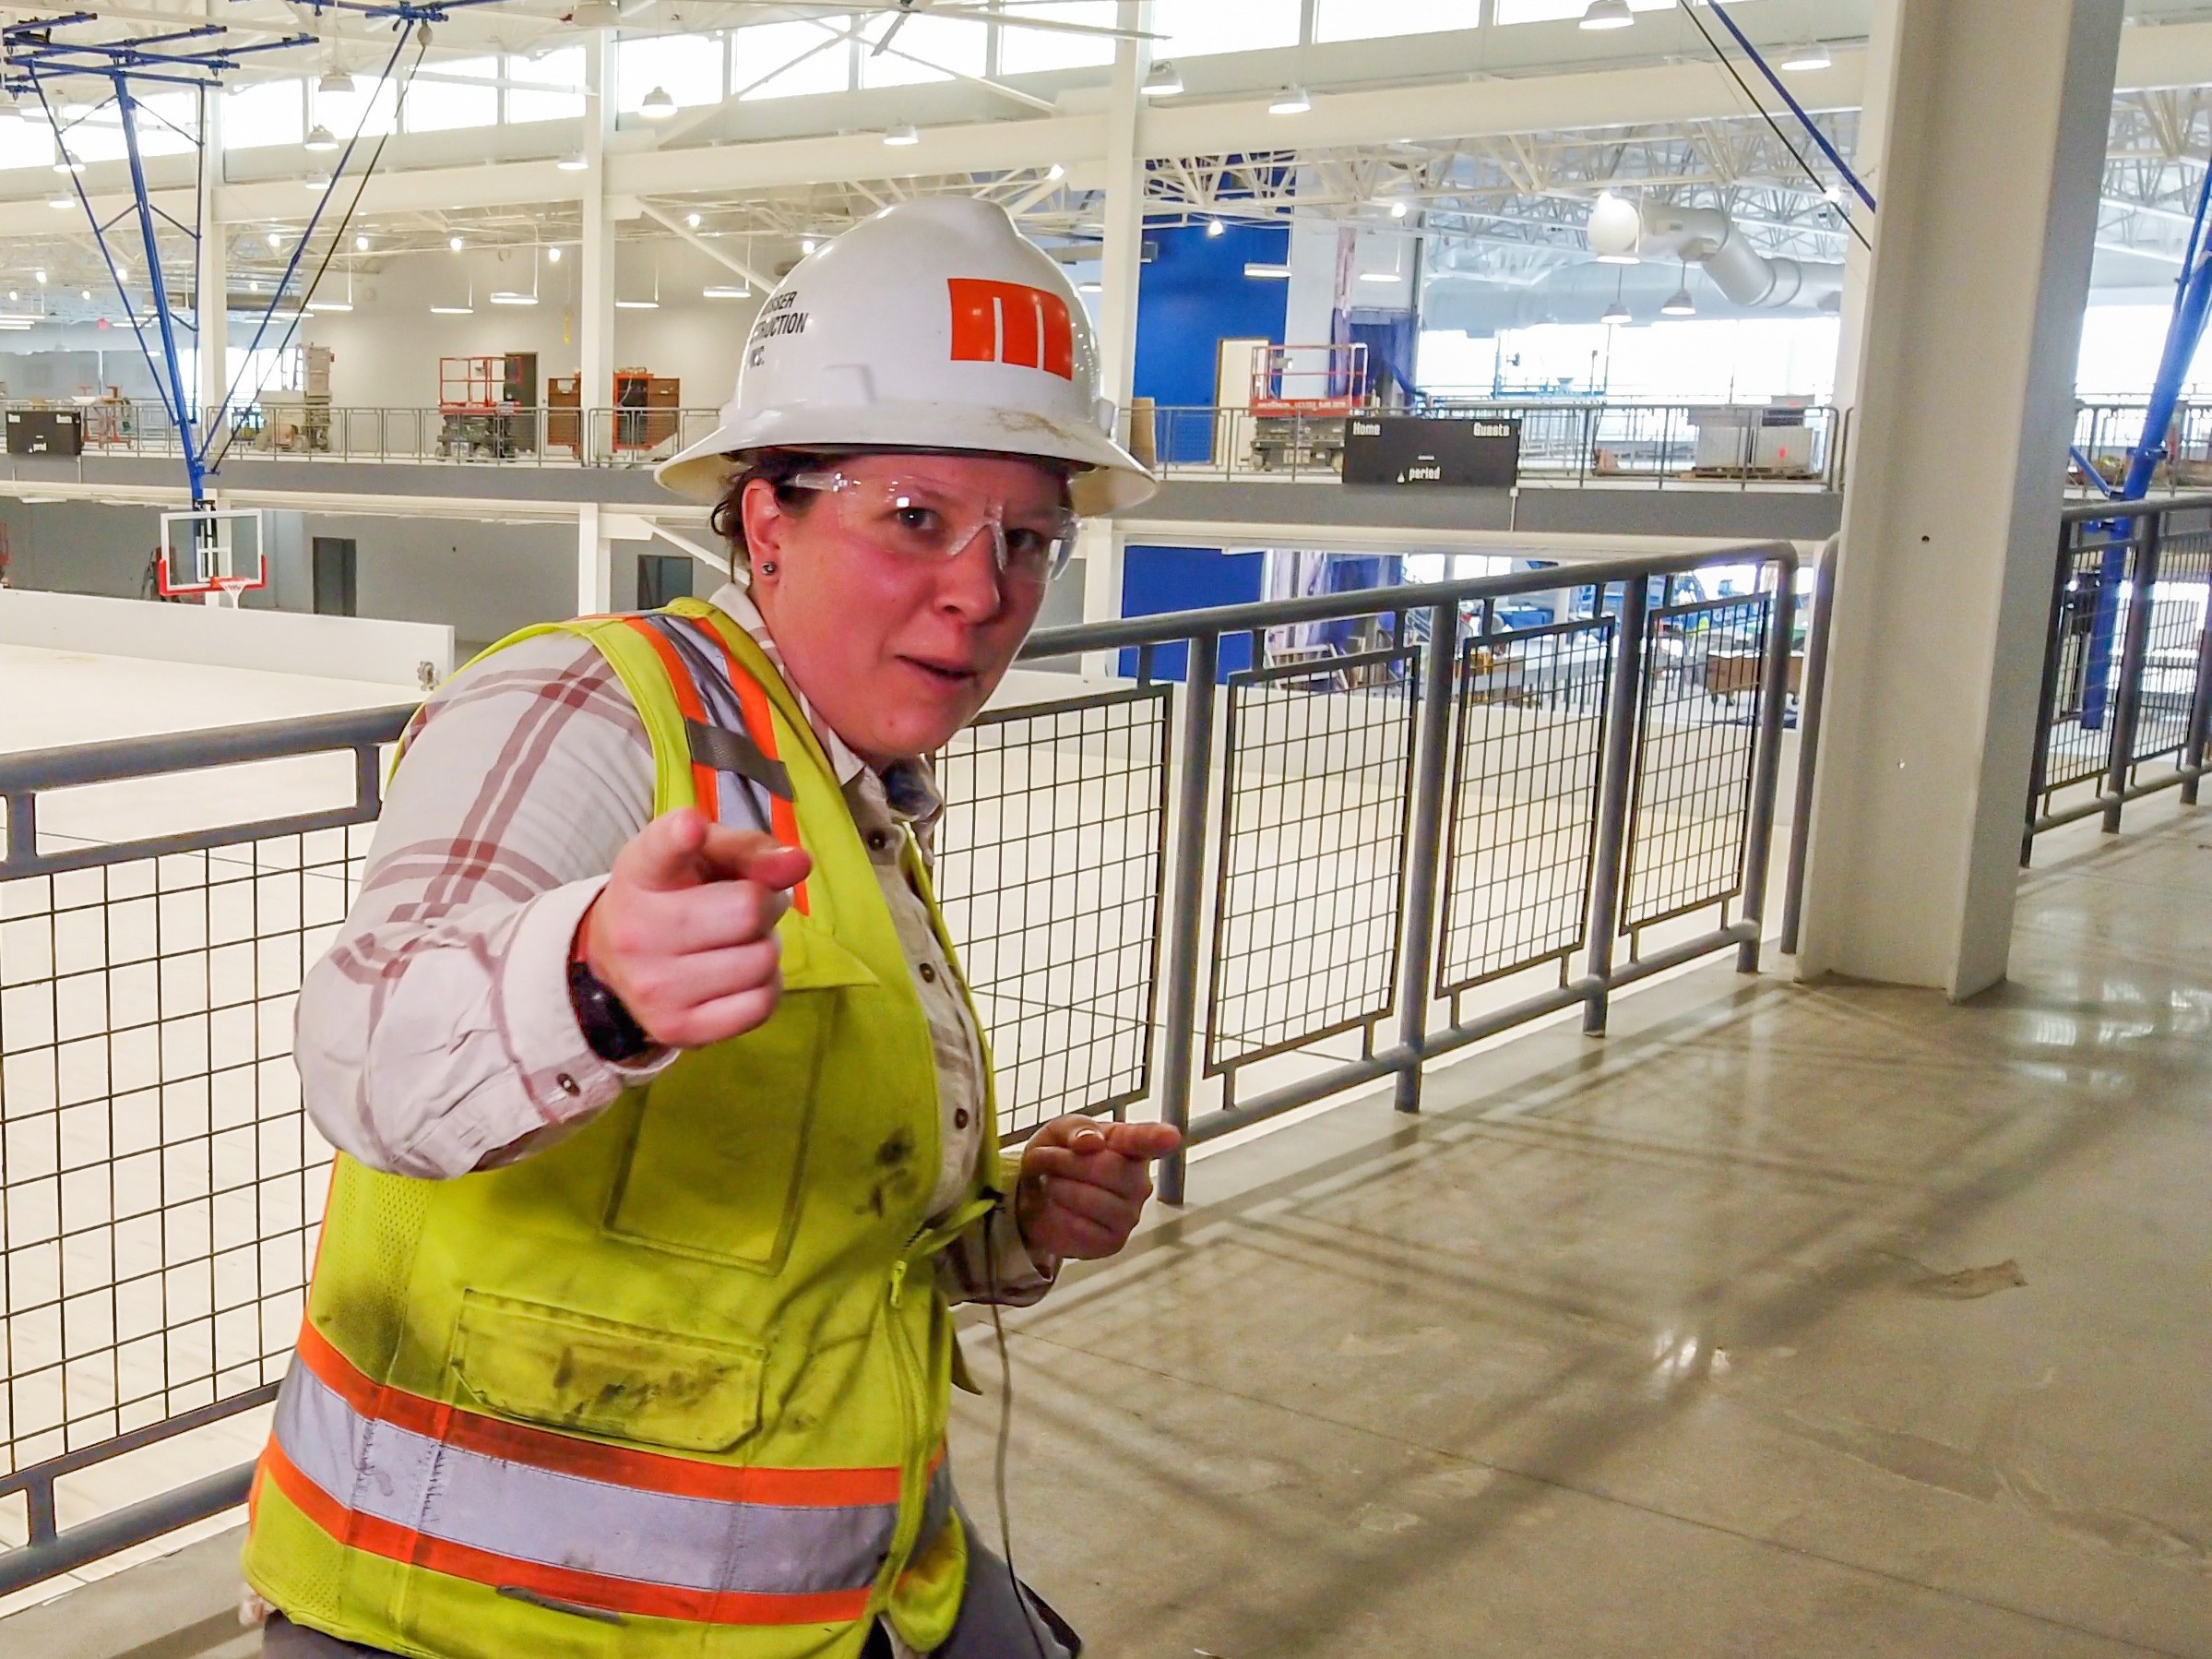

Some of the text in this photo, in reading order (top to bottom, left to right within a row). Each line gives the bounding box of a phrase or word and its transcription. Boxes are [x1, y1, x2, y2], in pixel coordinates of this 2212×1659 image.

[1352, 421, 1381, 436] Home
[1472, 422, 1510, 437] Guests
[1409, 465, 1441, 482] period
